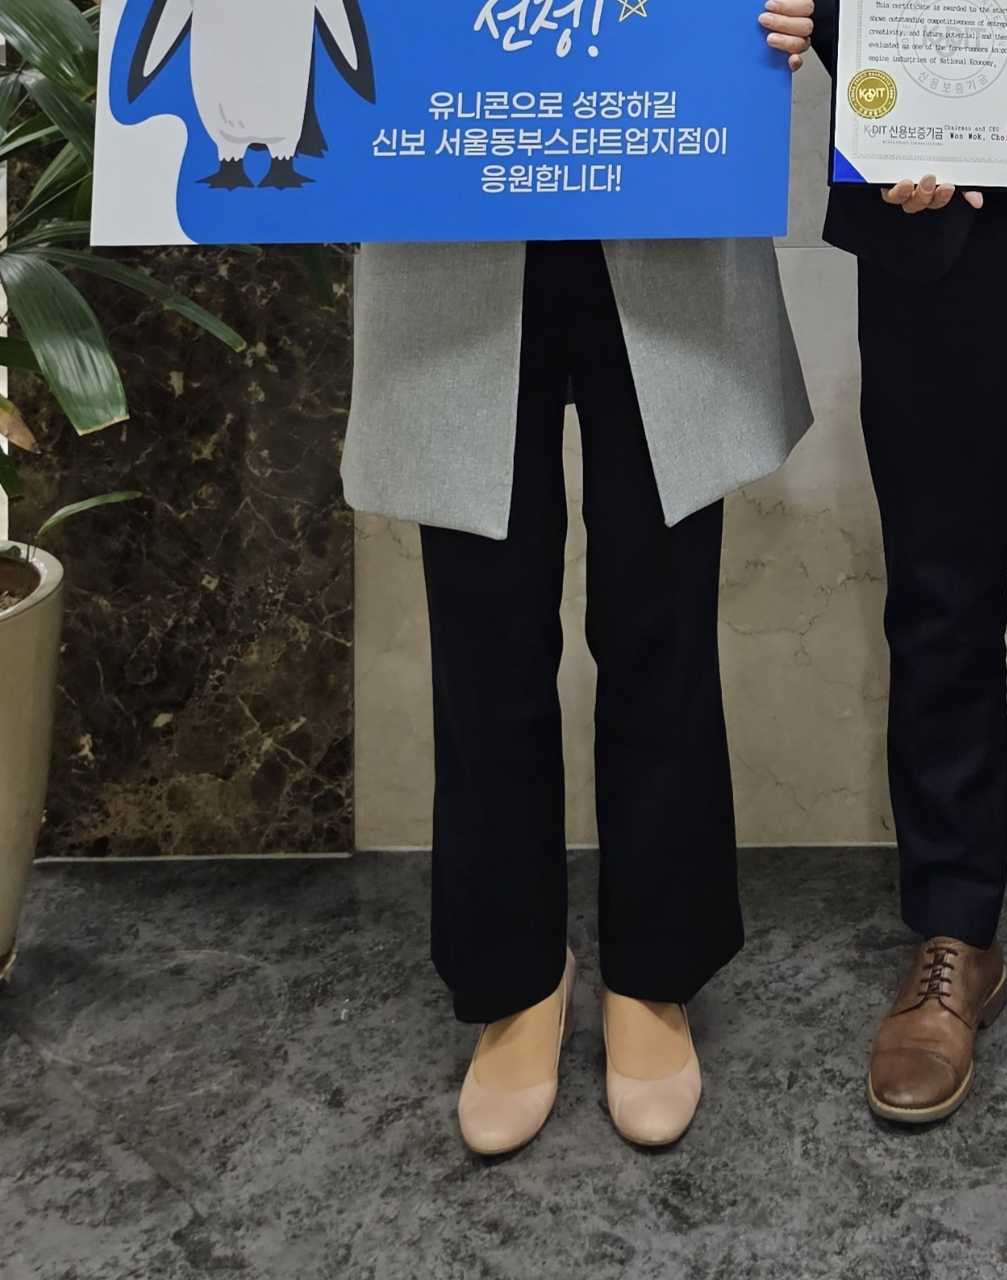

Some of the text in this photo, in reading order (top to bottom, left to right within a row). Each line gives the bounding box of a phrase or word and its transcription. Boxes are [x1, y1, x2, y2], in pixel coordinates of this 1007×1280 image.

[428, 91, 677, 120] 유니콘으로 성장하길
[371, 127, 728, 158] 신보 서울동부스타트업지점이
[889, 125, 944, 140] 신용보증기금
[480, 164, 622, 194] 응원합니다!
